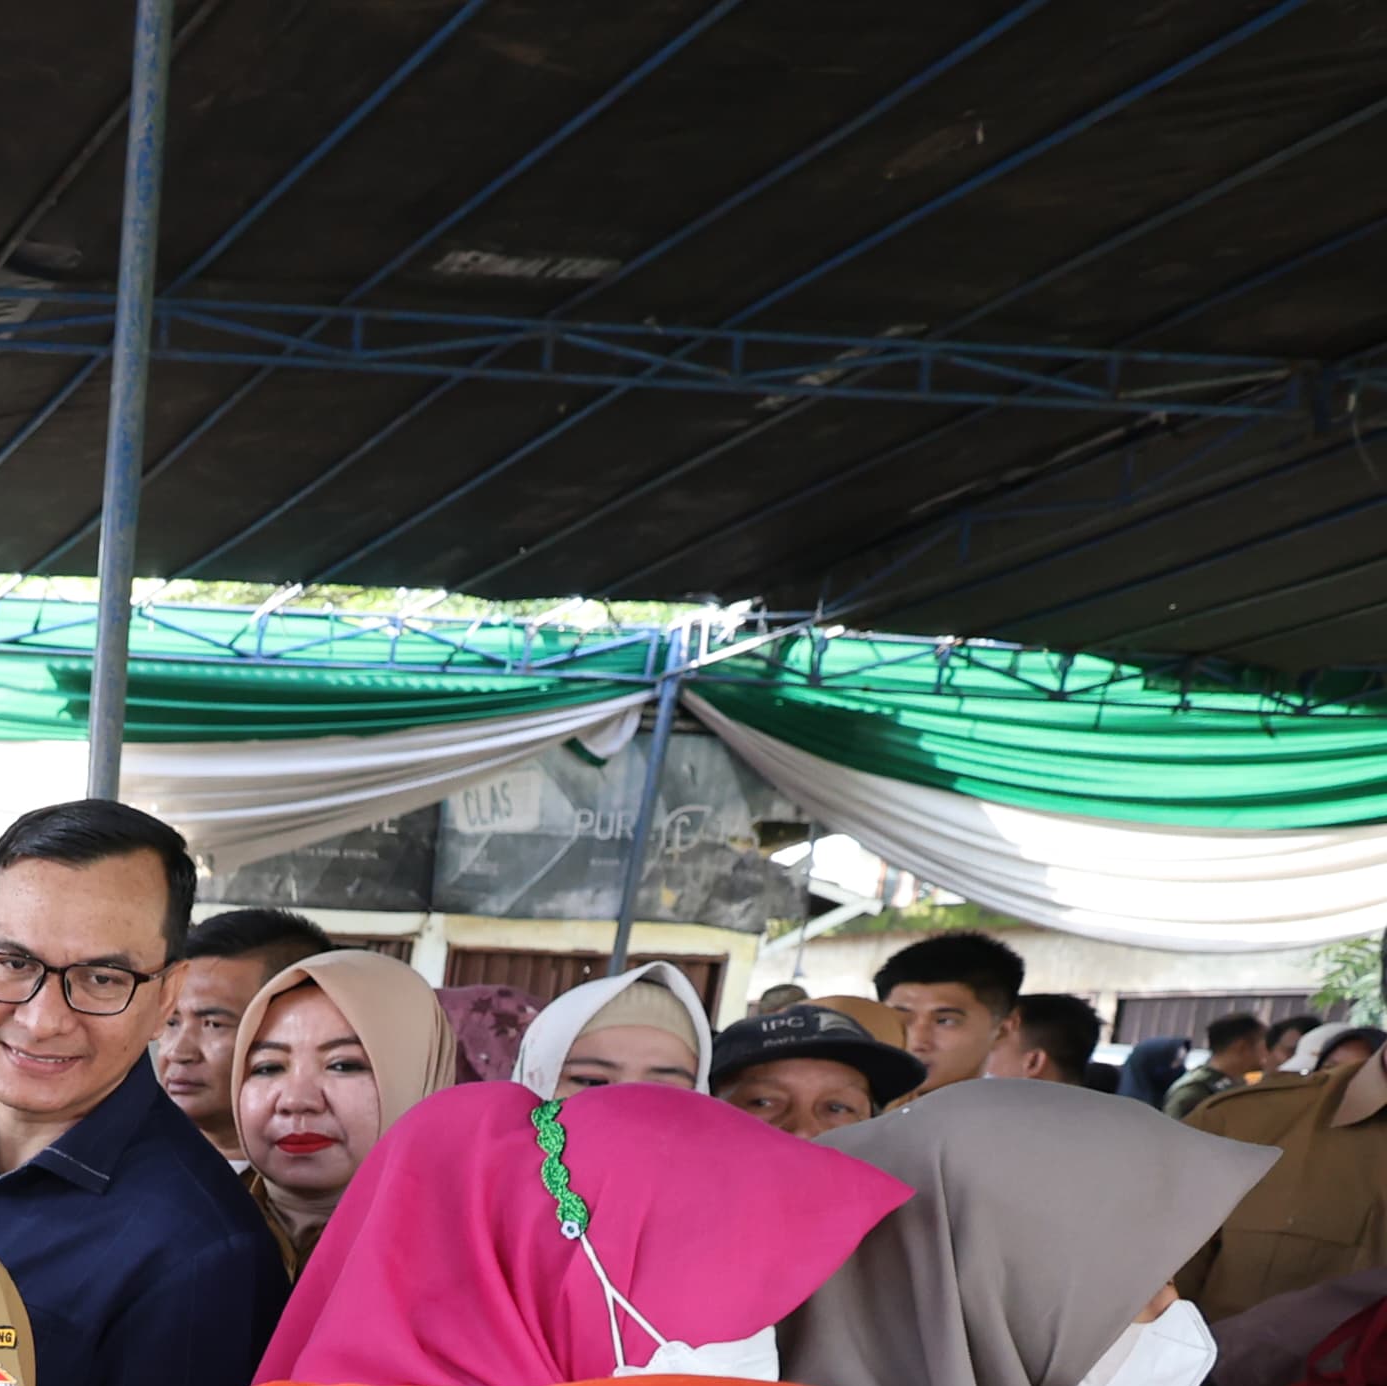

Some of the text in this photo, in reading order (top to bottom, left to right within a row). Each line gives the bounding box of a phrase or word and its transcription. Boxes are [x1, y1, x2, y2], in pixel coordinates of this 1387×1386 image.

[463, 781, 514, 826] CLAS
[577, 808, 637, 840] PUR
[761, 1015, 805, 1032] IPC
